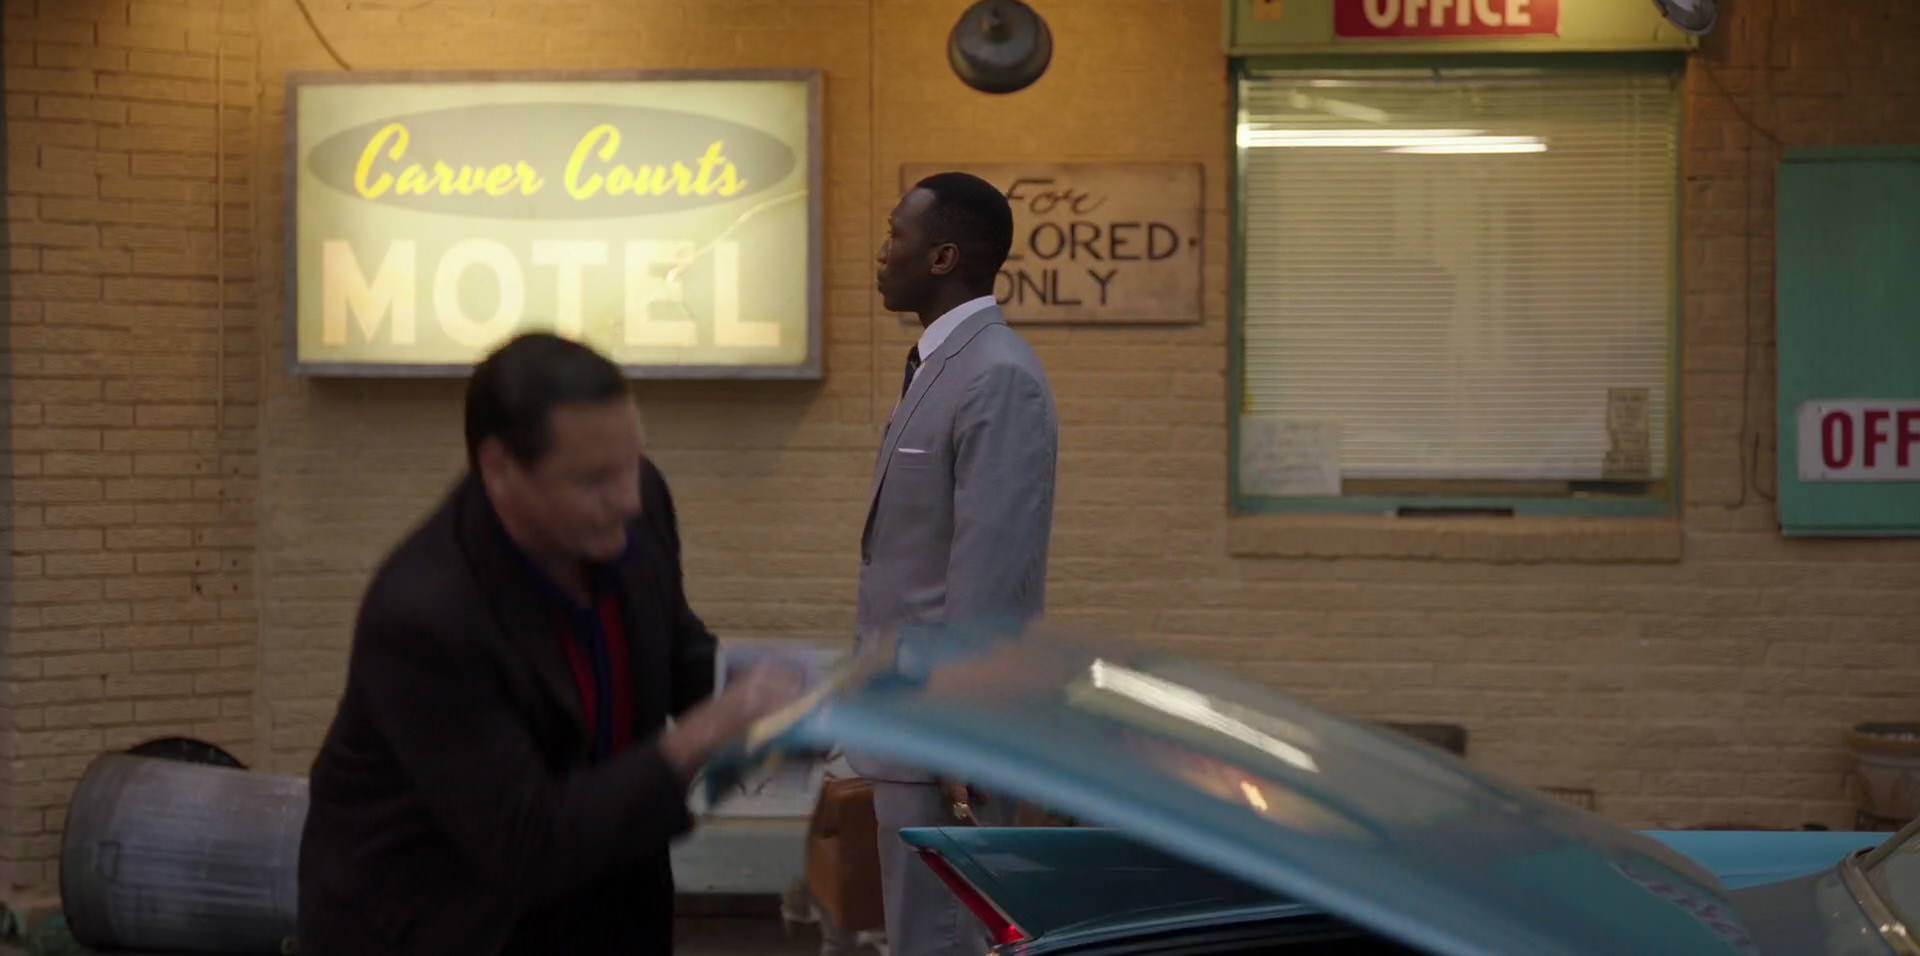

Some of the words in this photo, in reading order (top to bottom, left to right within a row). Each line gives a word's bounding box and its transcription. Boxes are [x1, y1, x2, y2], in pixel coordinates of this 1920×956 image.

[354, 122, 545, 199] Carver
[564, 124, 748, 199] Courts
[1006, 178, 1107, 215] For
[323, 238, 780, 347] MOTEL
